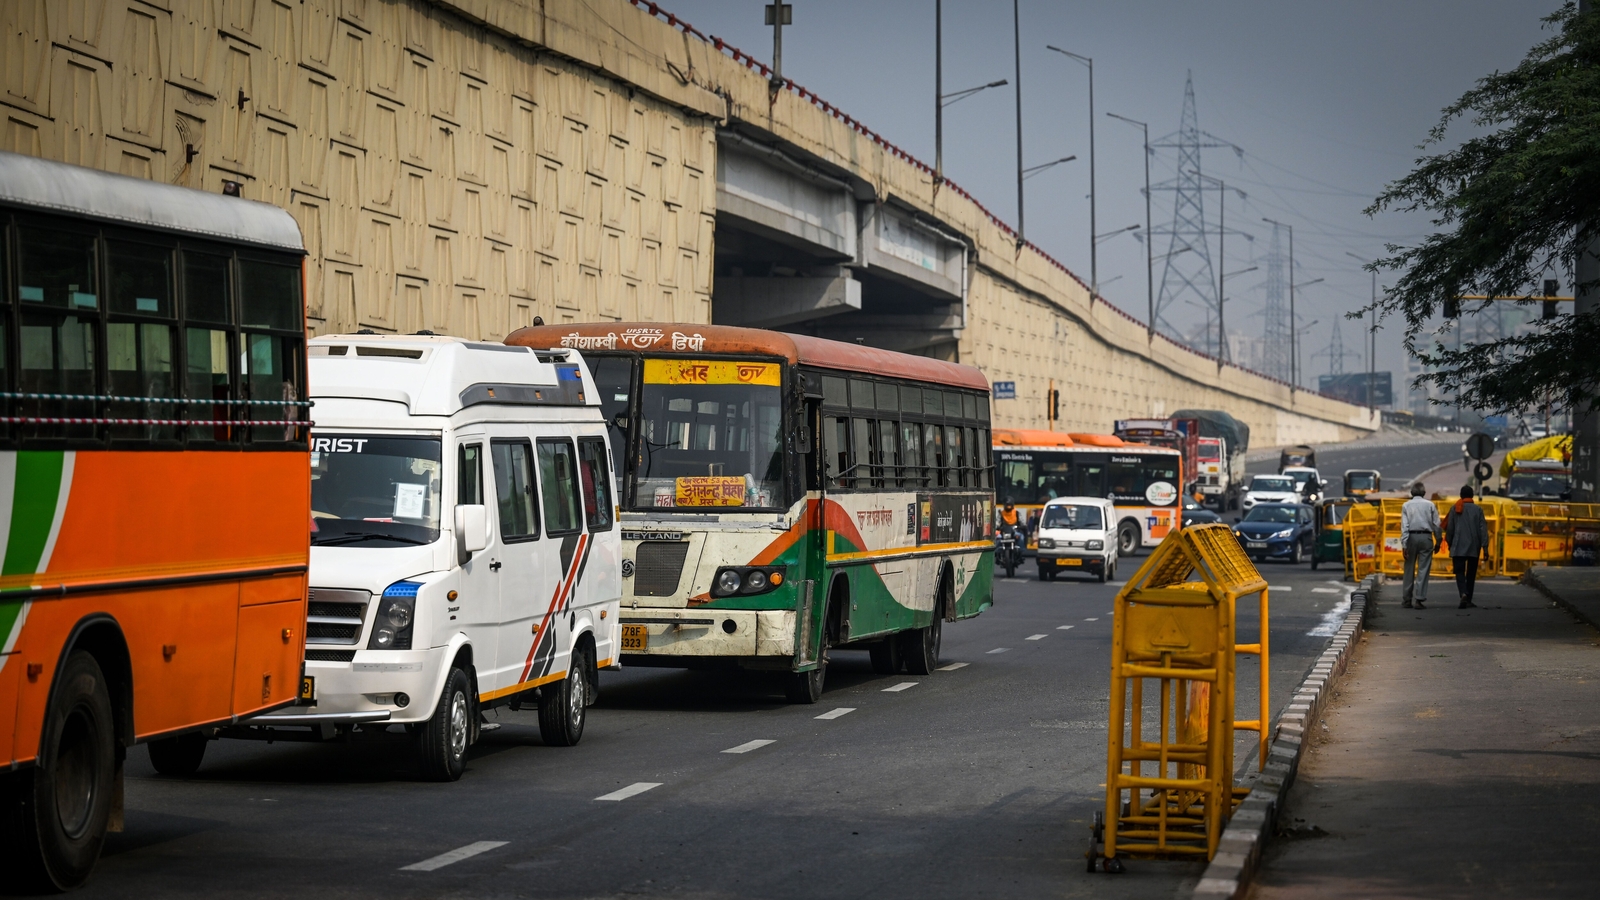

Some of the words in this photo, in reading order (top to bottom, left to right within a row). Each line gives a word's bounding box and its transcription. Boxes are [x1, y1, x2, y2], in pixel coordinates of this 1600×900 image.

[560, 332, 618, 350] कौशाम्बी
[672, 332, 706, 351] डिपो
[626, 532, 682, 540] LEYLAND
[1522, 539, 1547, 551] DELHI
[622, 626, 641, 636] 78F
